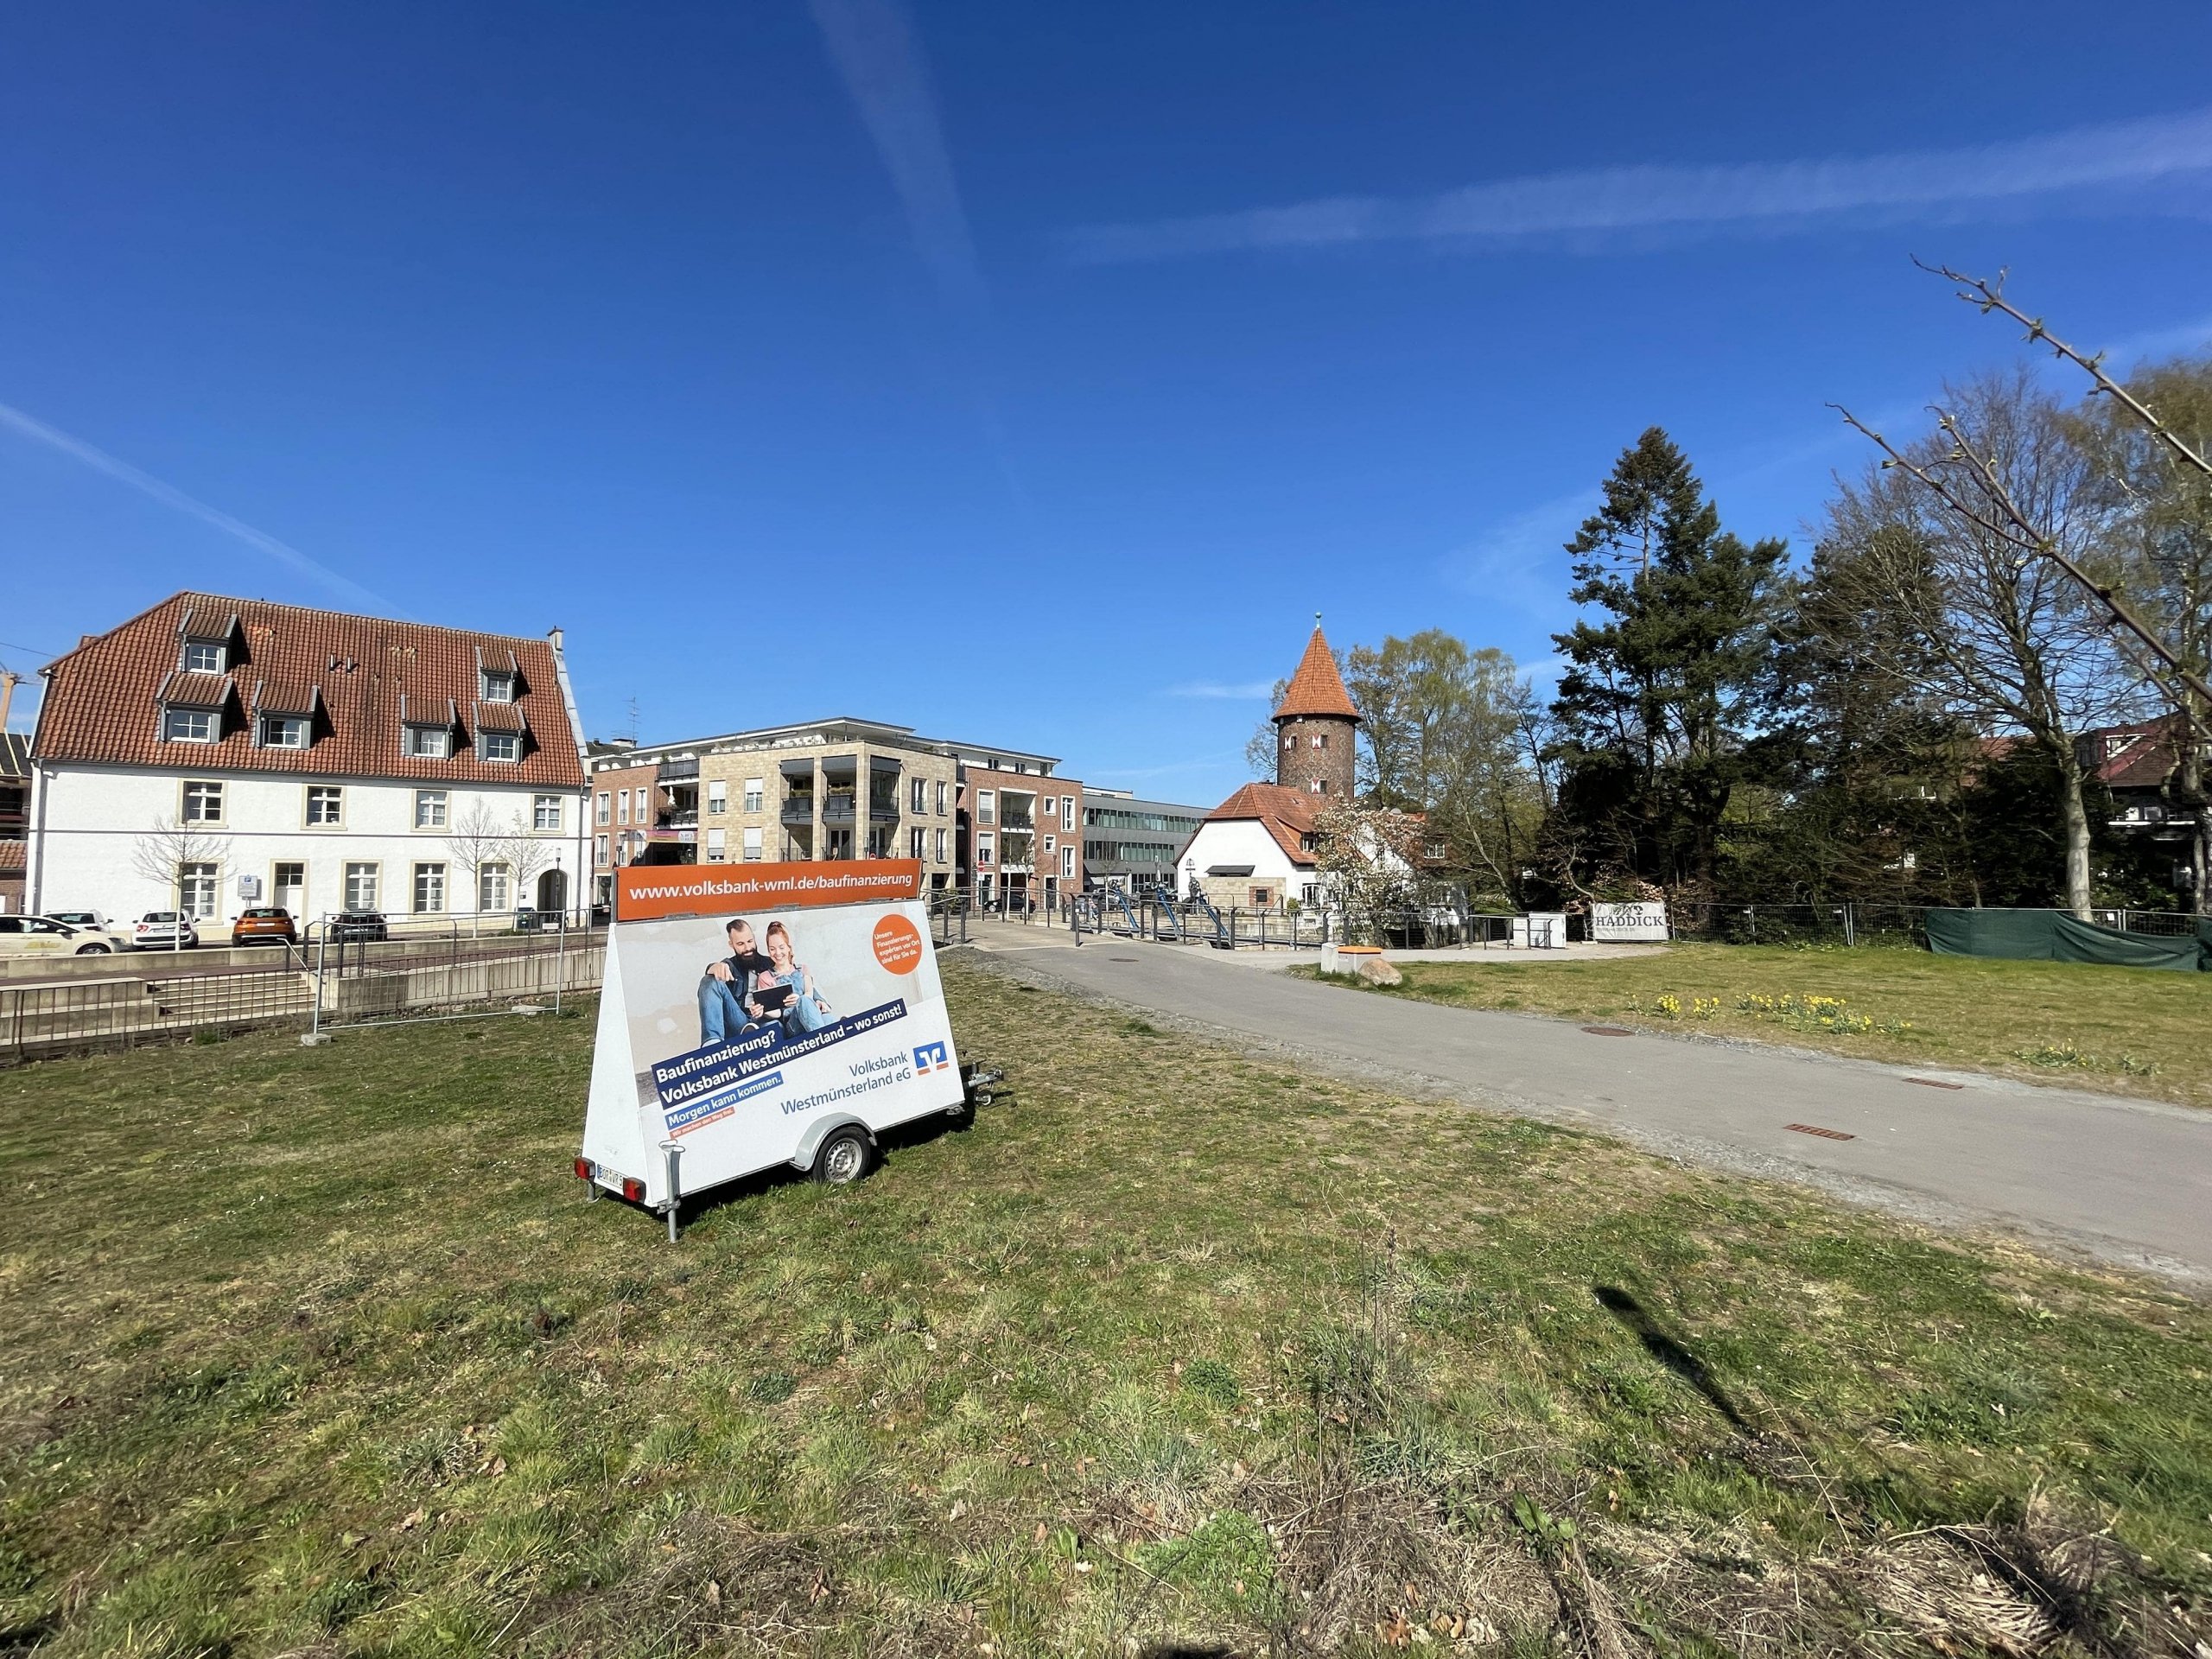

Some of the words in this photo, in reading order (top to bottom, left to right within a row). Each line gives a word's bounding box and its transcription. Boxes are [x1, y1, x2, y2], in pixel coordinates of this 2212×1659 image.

[629, 874, 912, 900] www.volksbank-wml.de/baufinanzierung
[1595, 916, 1664, 927] HADDICK
[657, 1030, 776, 1084] Baufinanzierung?
[661, 1065, 739, 1104] Volksbank
[738, 1025, 846, 1076] Westmünsterland
[855, 1019, 872, 1031] wo
[873, 1004, 903, 1025] sonst!
[849, 1051, 908, 1077] Volksbank
[668, 1104, 711, 1127] Morgen
[711, 1092, 737, 1109] kann
[737, 1076, 781, 1099] kommen.
[780, 1072, 893, 1116] Westmünsterland
[895, 1066, 912, 1083] eG
